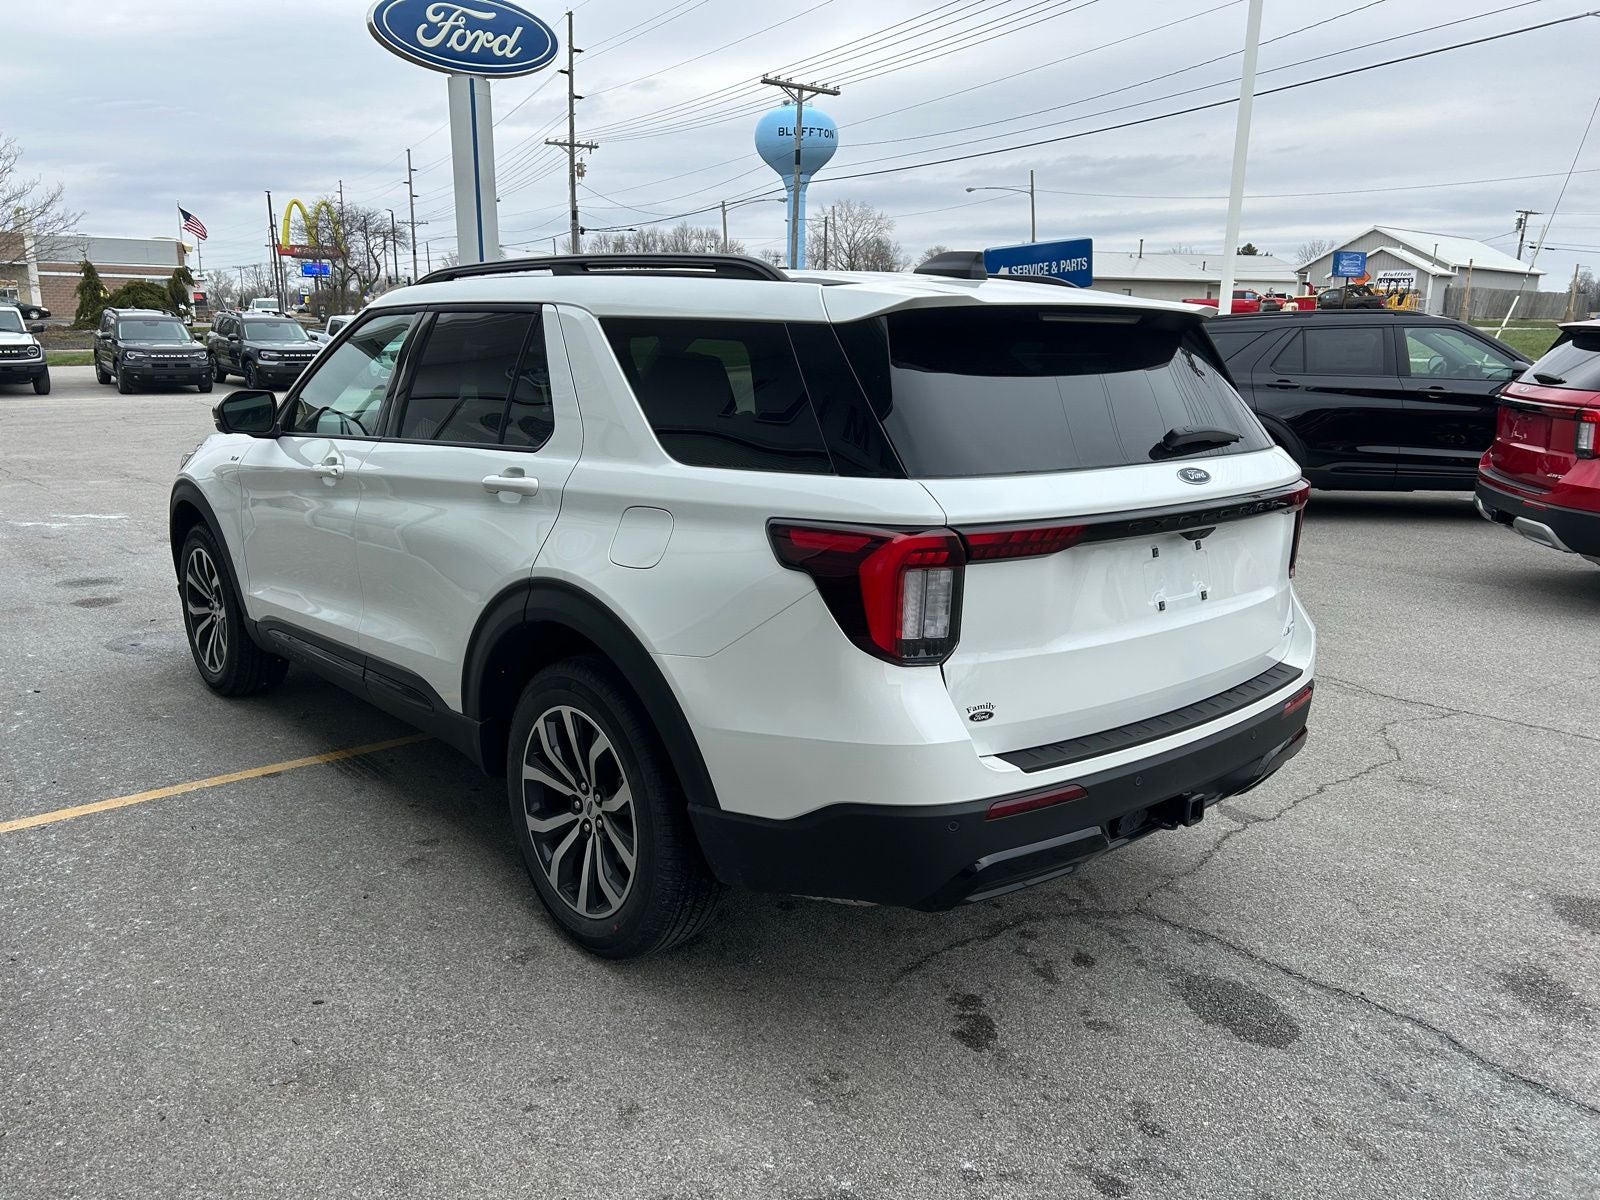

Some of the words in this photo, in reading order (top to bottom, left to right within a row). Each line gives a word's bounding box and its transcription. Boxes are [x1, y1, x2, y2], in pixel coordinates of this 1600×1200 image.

[416, 2, 523, 59] Ford
[1011, 262, 1049, 275] SERVICE
[1051, 260, 1058, 273] &
[1060, 257, 1088, 272] PARTS
[966, 702, 996, 714] Family
